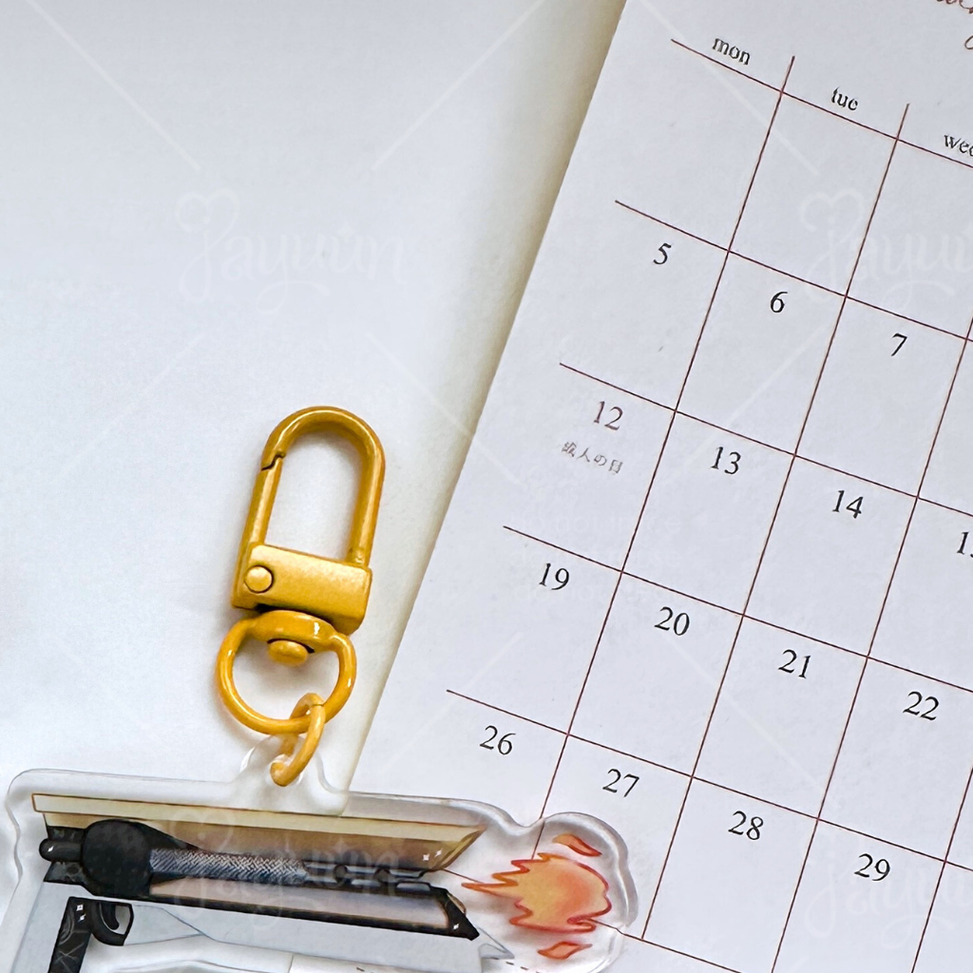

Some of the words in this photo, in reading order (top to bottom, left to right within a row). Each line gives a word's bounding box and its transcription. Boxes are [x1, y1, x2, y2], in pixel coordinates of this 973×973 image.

[712, 37, 751, 66] mon
[831, 87, 859, 112] tue
[653, 242, 672, 266] 5
[769, 290, 789, 314] 6
[890, 332, 908, 357] 7
[593, 400, 624, 431] 12
[710, 446, 742, 475] 13
[831, 489, 864, 520] 14
[957, 531, 973, 558] 1
[538, 562, 570, 591] 19
[654, 606, 691, 637] 20
[777, 648, 812, 680] 21
[902, 690, 940, 722] 22
[479, 724, 517, 756] 26
[602, 768, 641, 798] 27
[727, 810, 764, 841] 28
[853, 852, 891, 882] 29
